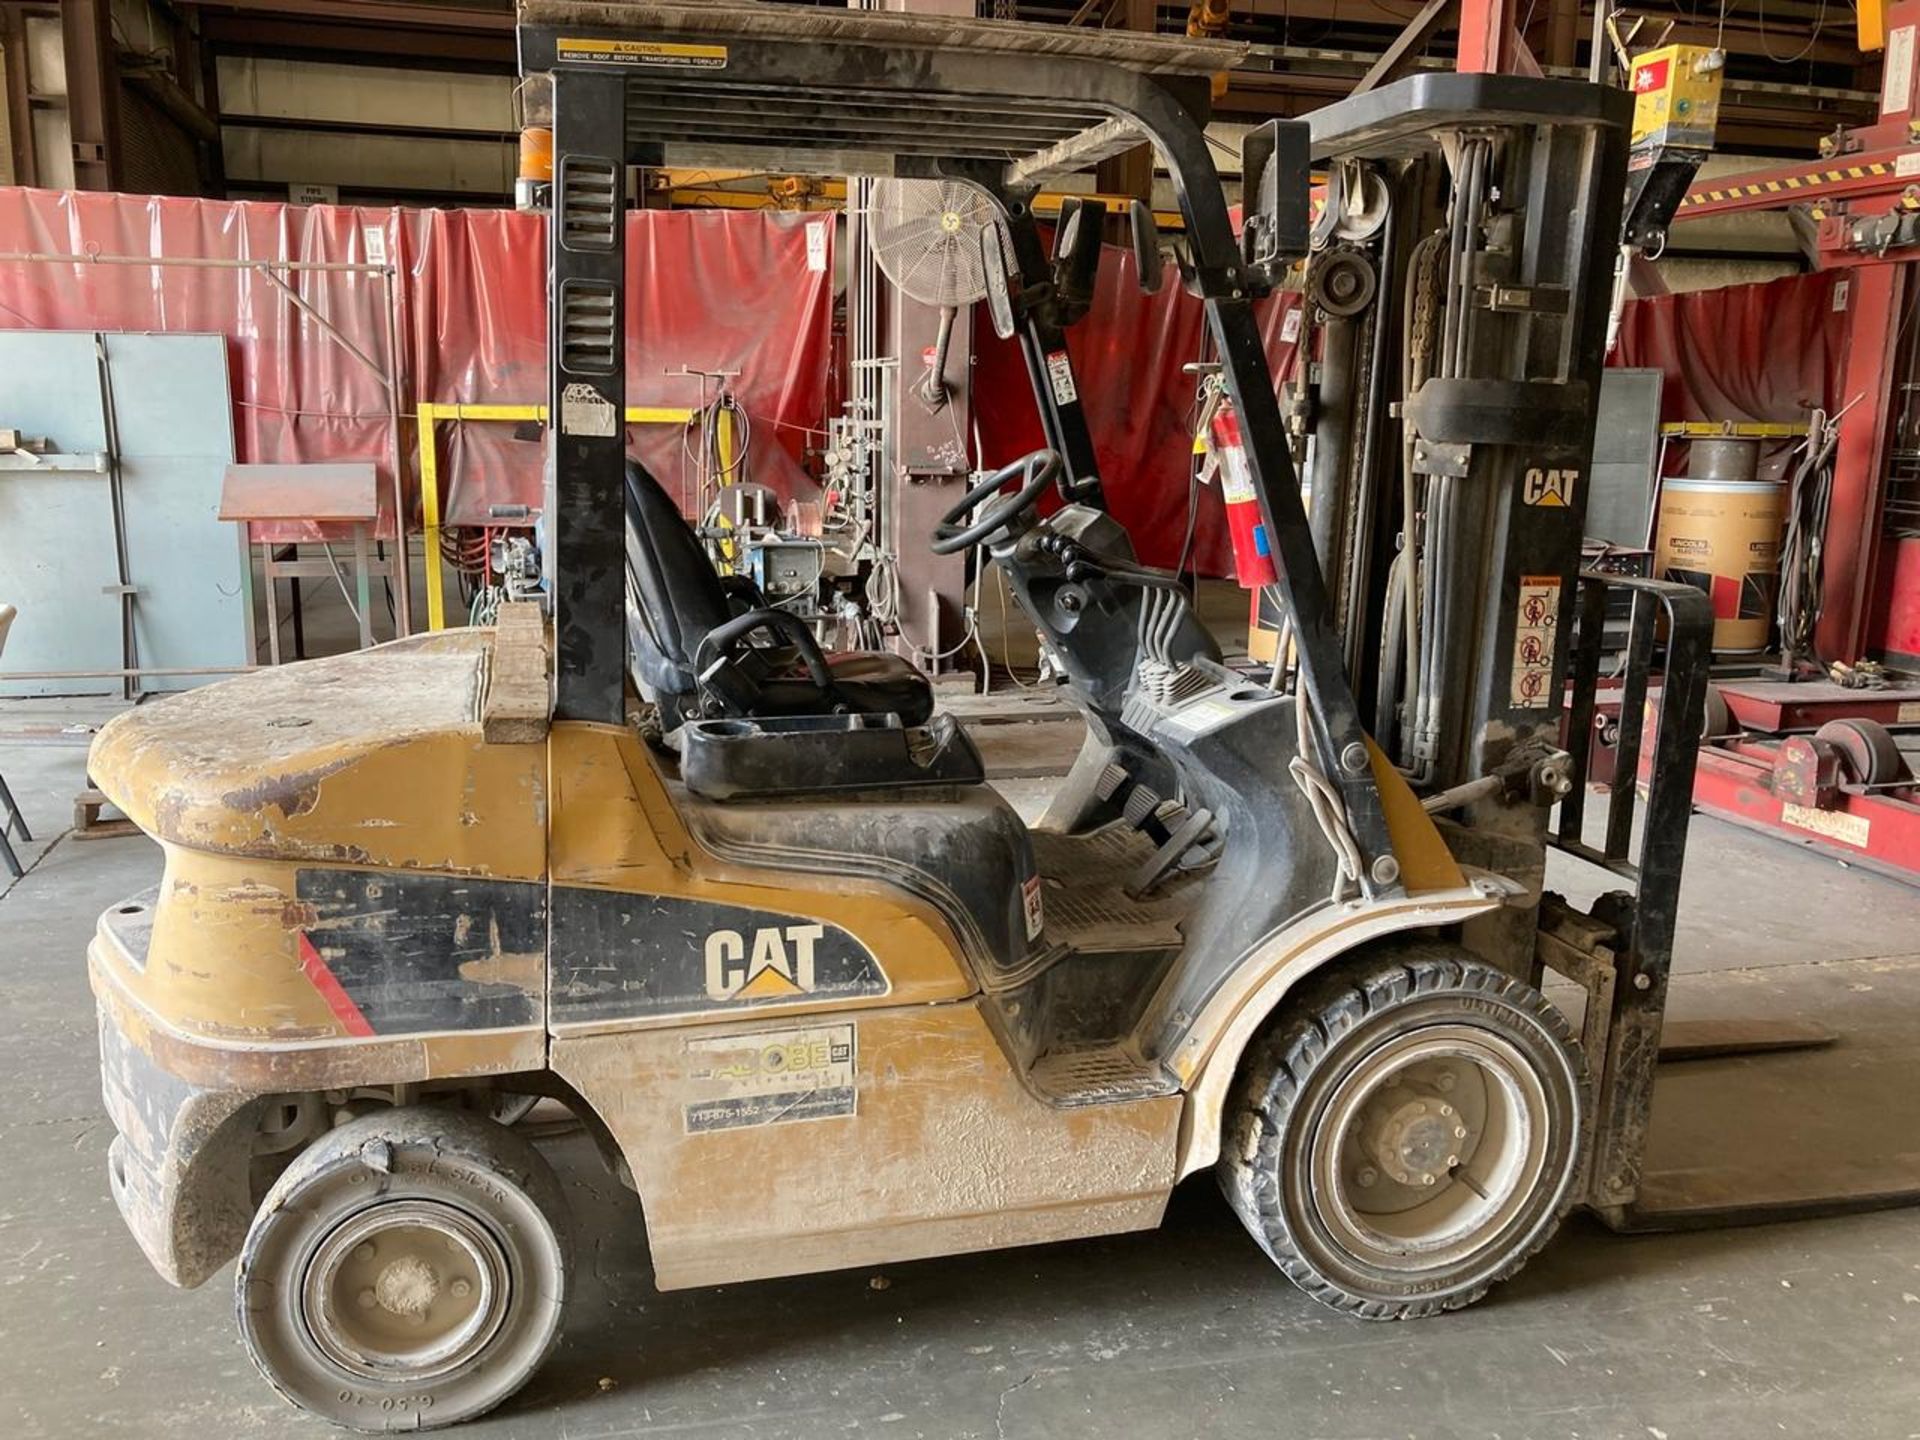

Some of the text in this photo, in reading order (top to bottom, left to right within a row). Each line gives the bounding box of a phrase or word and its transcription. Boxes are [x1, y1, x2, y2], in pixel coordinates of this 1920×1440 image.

[624, 43, 662, 53] CAUTION
[563, 52, 590, 60] REMOVE
[613, 54, 639, 62] BEFORE
[641, 55, 691, 65] TRANSPORTING
[692, 57, 723, 66] FORKLIFT
[1523, 467, 1579, 507] CAT
[1671, 538, 1707, 548] LINCOLN
[705, 924, 824, 1001] CAT
